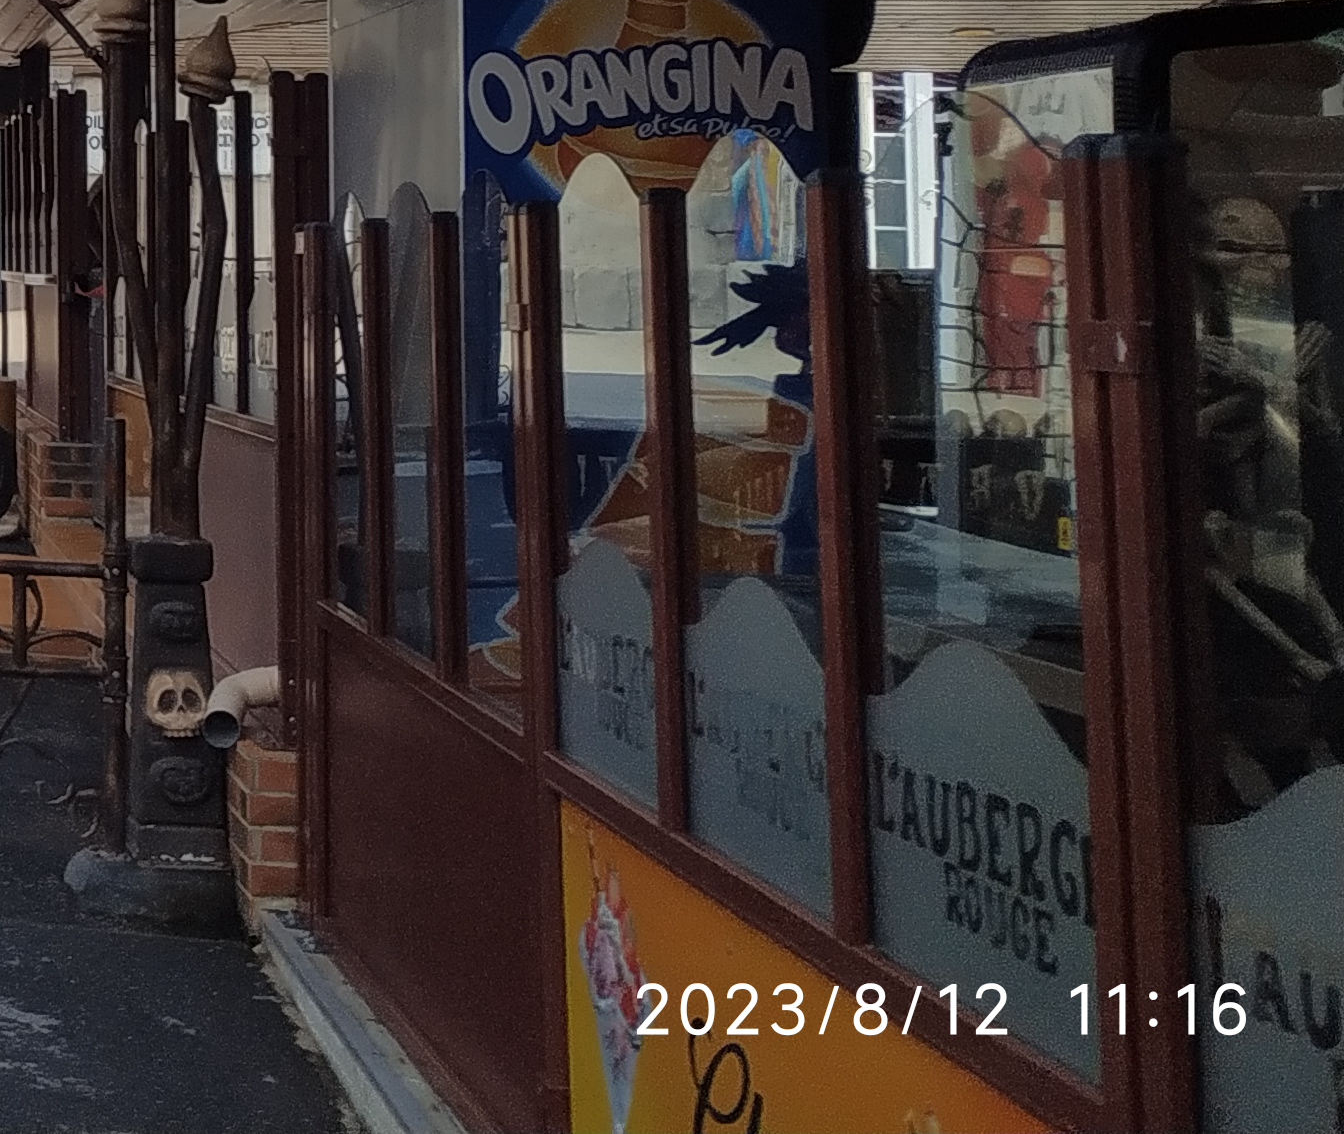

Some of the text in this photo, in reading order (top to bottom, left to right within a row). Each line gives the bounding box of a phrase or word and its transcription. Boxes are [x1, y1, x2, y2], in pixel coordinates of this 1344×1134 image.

[468, 40, 814, 155] ORANGINA
[638, 112, 664, 138] et
[668, 116, 700, 136] sa
[944, 862, 1059, 977] ROUGE
